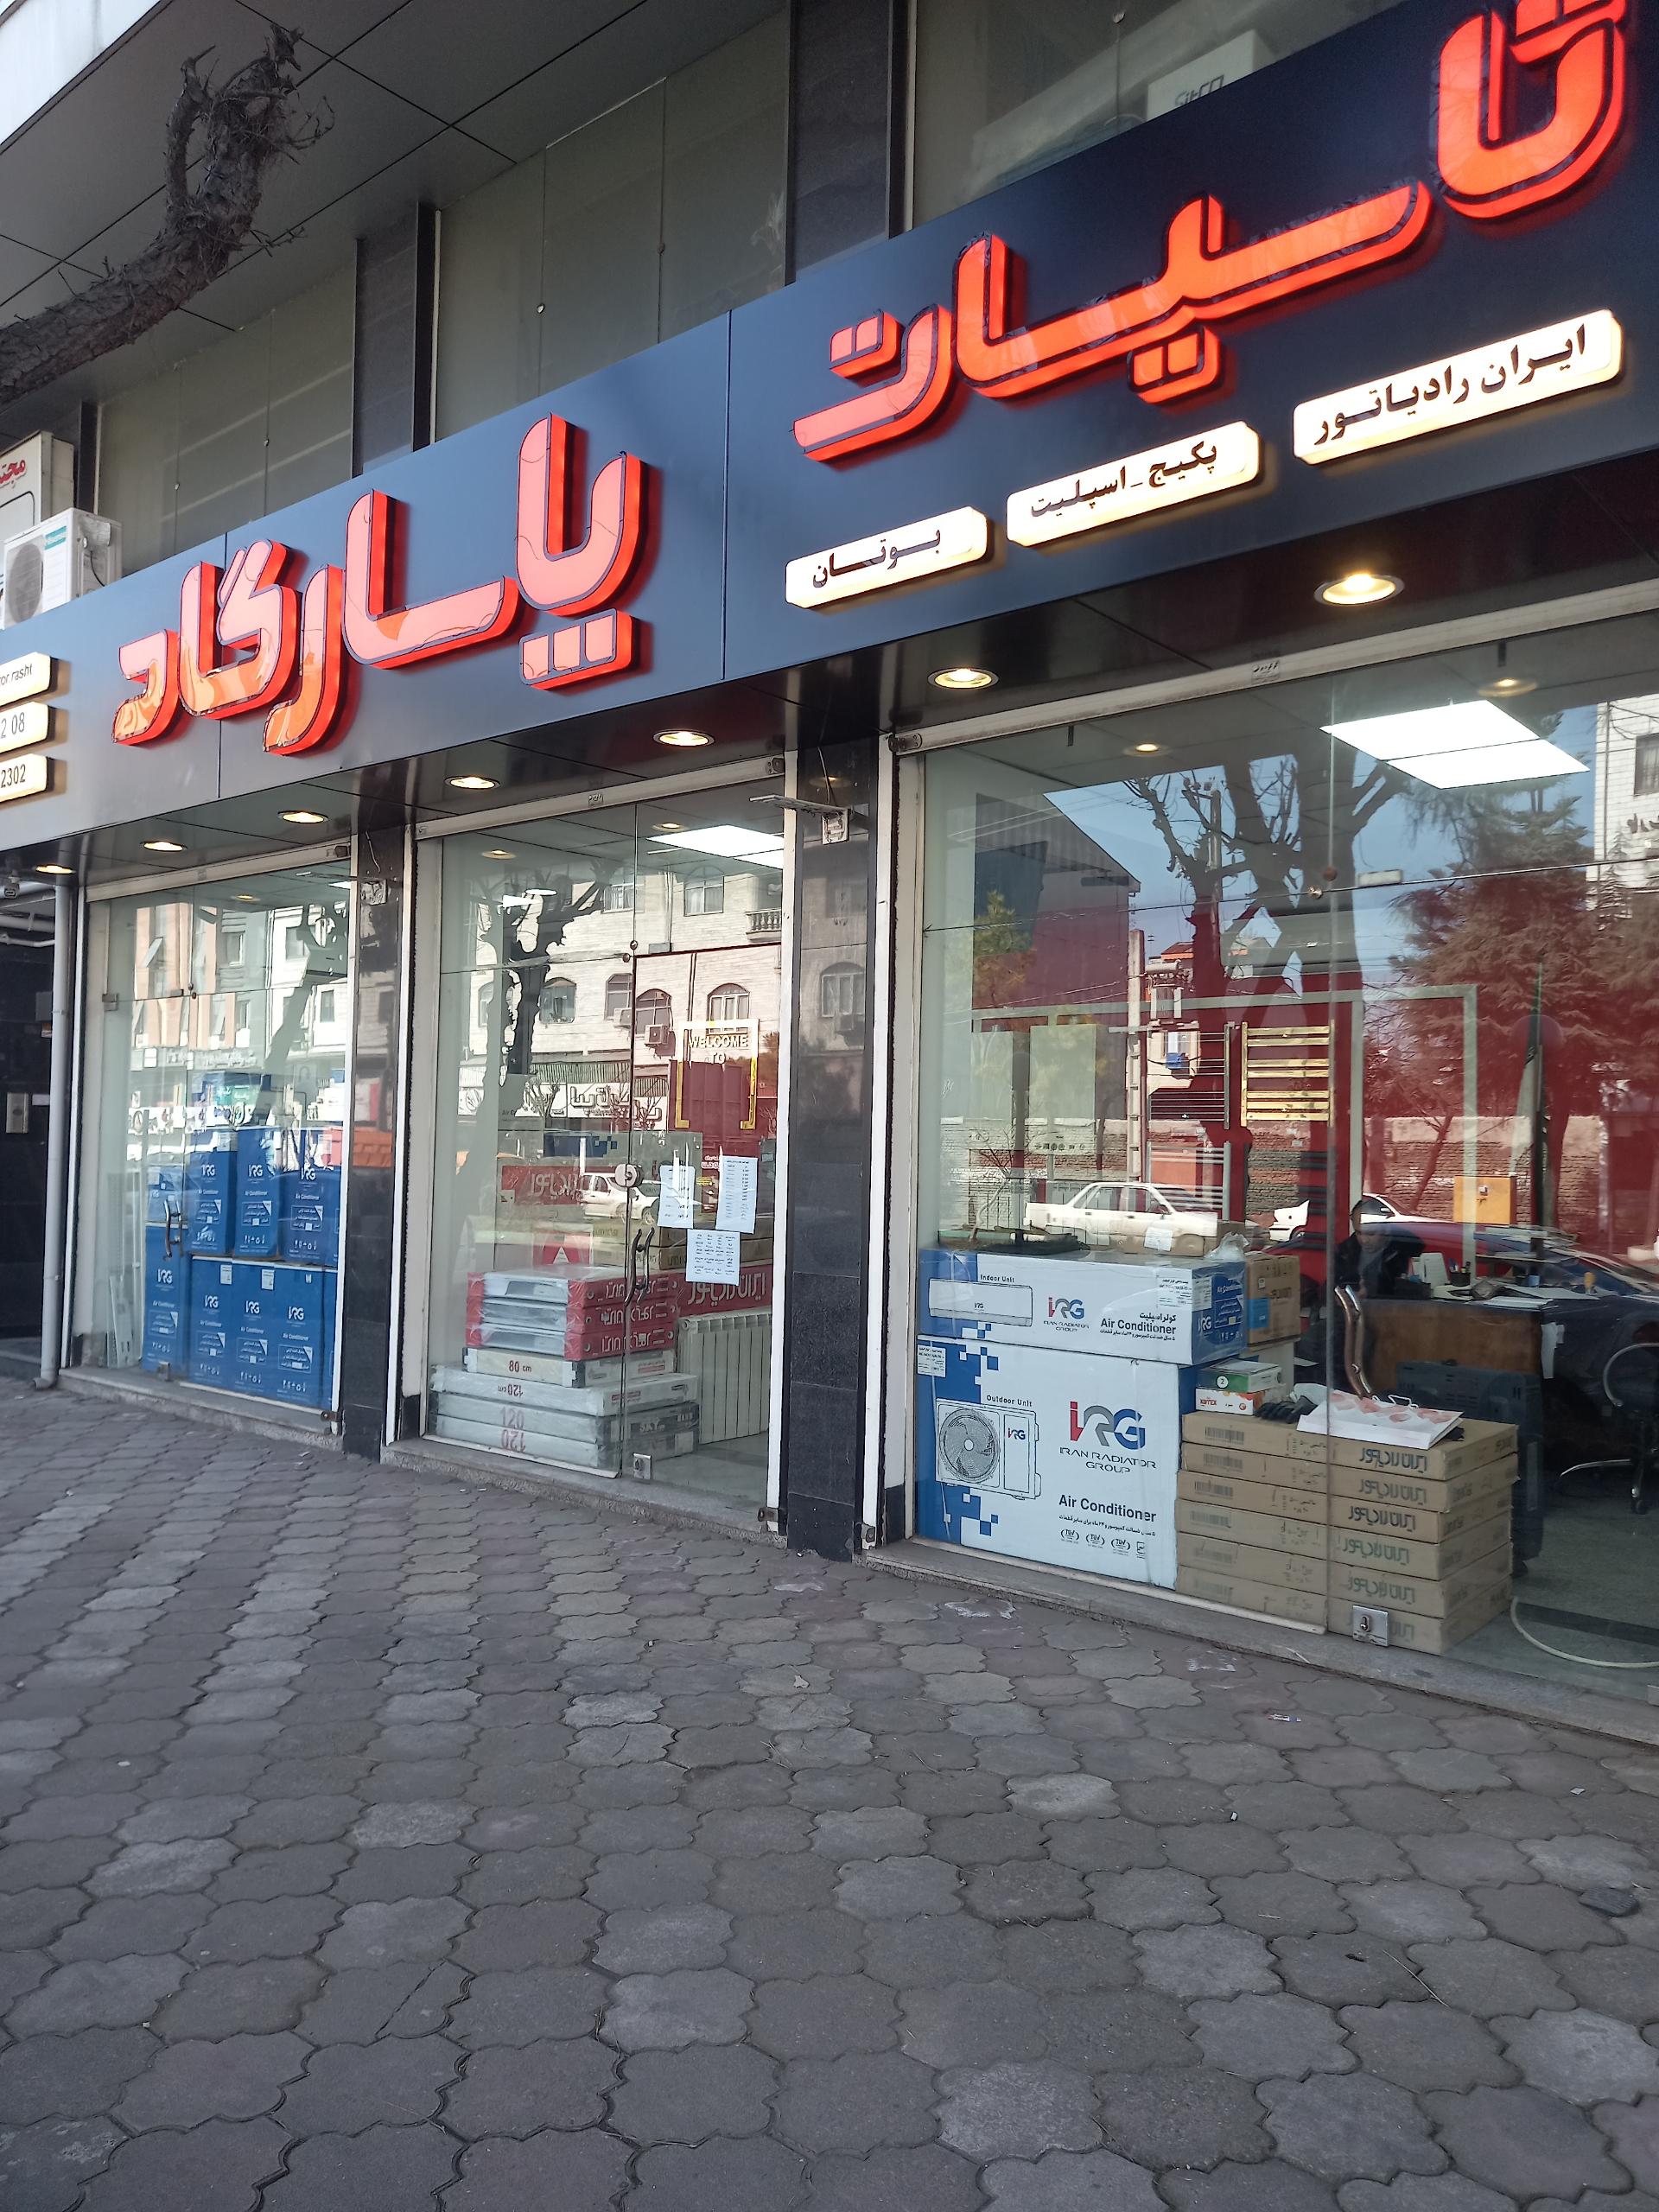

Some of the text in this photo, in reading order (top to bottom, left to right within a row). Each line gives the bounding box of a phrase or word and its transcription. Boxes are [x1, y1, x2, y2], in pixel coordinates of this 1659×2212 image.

[1314, 323, 1586, 445] ایران رادیاتور
[812, 529, 941, 588] بوتان
[738, 1272, 766, 1300] ایران
[1101, 1318, 1177, 1335] Air Conditioner
[509, 1360, 532, 1373] 80 cm
[986, 1395, 1033, 1408] Outdoor Unit
[1059, 1446, 1157, 1469] IRAN RADIATOR
[1085, 1461, 1130, 1473] GROUP
[1058, 1494, 1157, 1522] Air Conditioner
